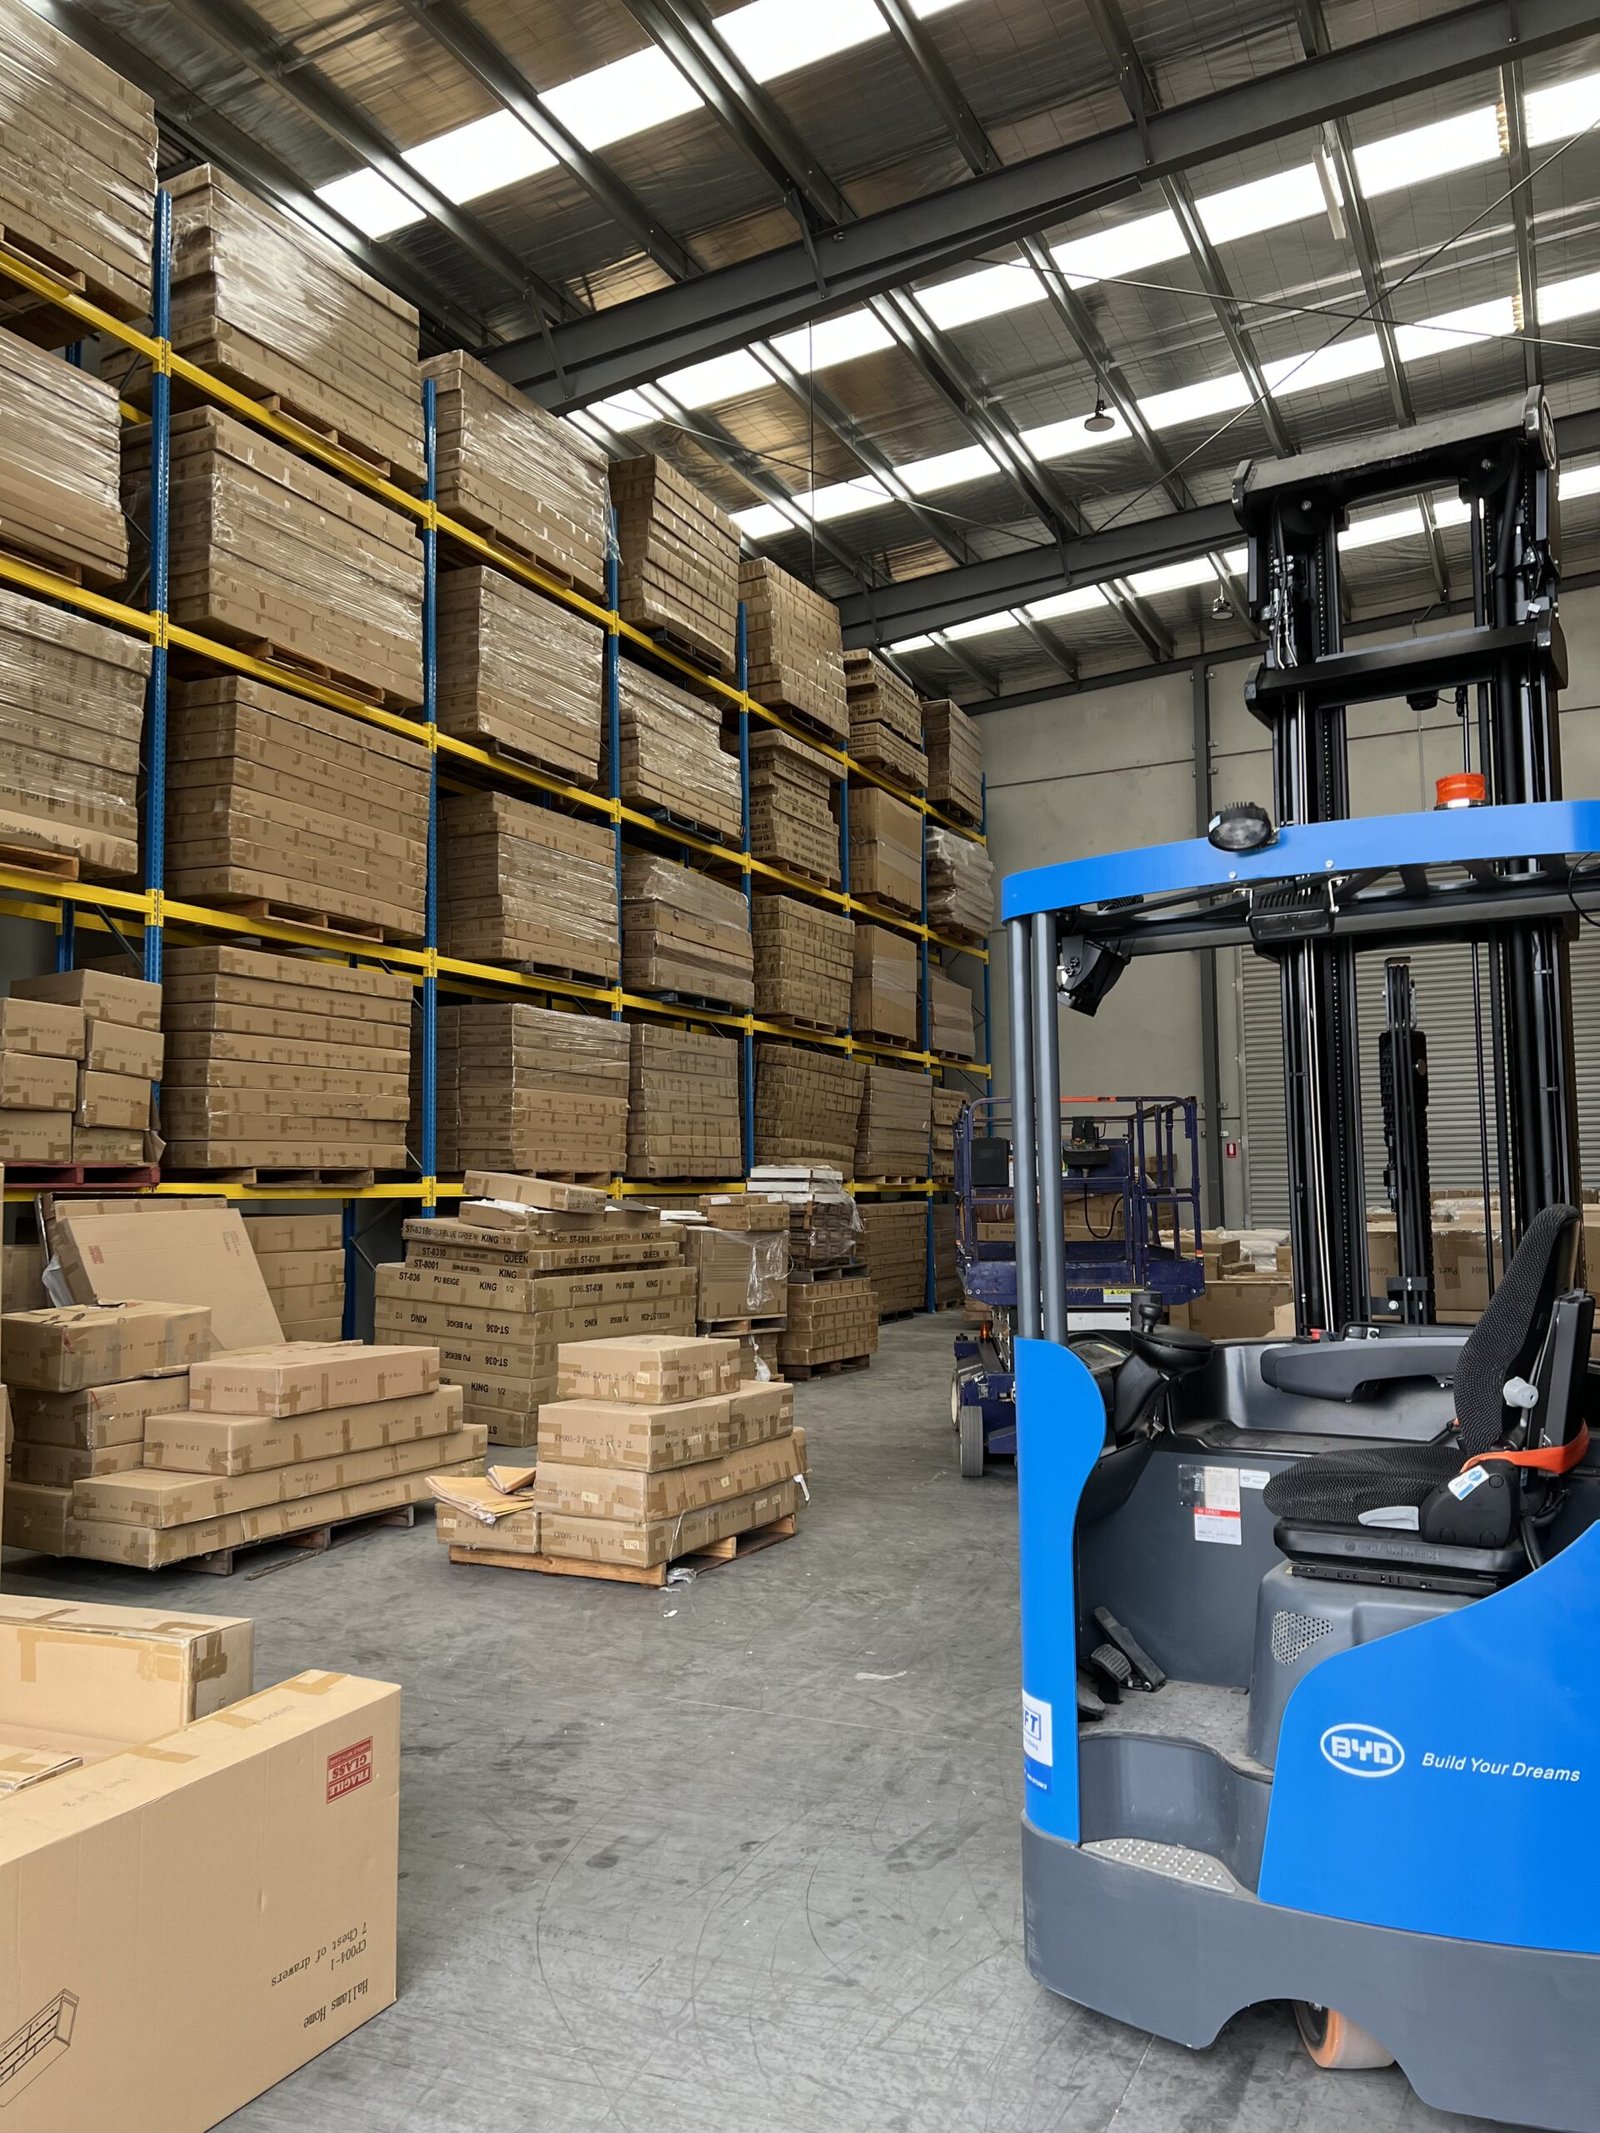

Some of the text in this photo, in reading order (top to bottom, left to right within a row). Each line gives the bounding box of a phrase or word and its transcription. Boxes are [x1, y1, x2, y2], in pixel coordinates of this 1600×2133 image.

[481, 1233, 499, 1244] KING
[503, 1254, 529, 1264] QUEEN
[642, 1250, 660, 1259] QUEEN
[498, 1268, 517, 1279] KING
[1438, 1265, 1459, 1275] Part
[399, 1272, 420, 1282] ST-036
[433, 1275, 442, 1284] PU
[442, 1276, 460, 1286] BEIGE
[479, 1281, 497, 1291] KING
[646, 1280, 658, 1288] KING
[410, 1313, 428, 1324] KING
[446, 1319, 462, 1329] BEIGE
[584, 1318, 598, 1328] KING
[463, 1322, 473, 1331] PU
[486, 1323, 510, 1335] ST-036
[444, 1351, 509, 1367] ST-036 PU BEIGE
[471, 1382, 489, 1393] KING
[582, 1436, 597, 1445] Part
[582, 1534, 598, 1543] Part
[1331, 1735, 1394, 1765] BYD
[332, 1754, 367, 1780] GLASS
[1422, 1752, 1581, 1783] Build Your Dreams
[329, 1767, 370, 1796] FRAGILE
[271, 1921, 367, 1987] 7 Chest of drawers
[330, 1938, 367, 1971] CP004-1
[303, 1978, 369, 2029] Hallams Home
